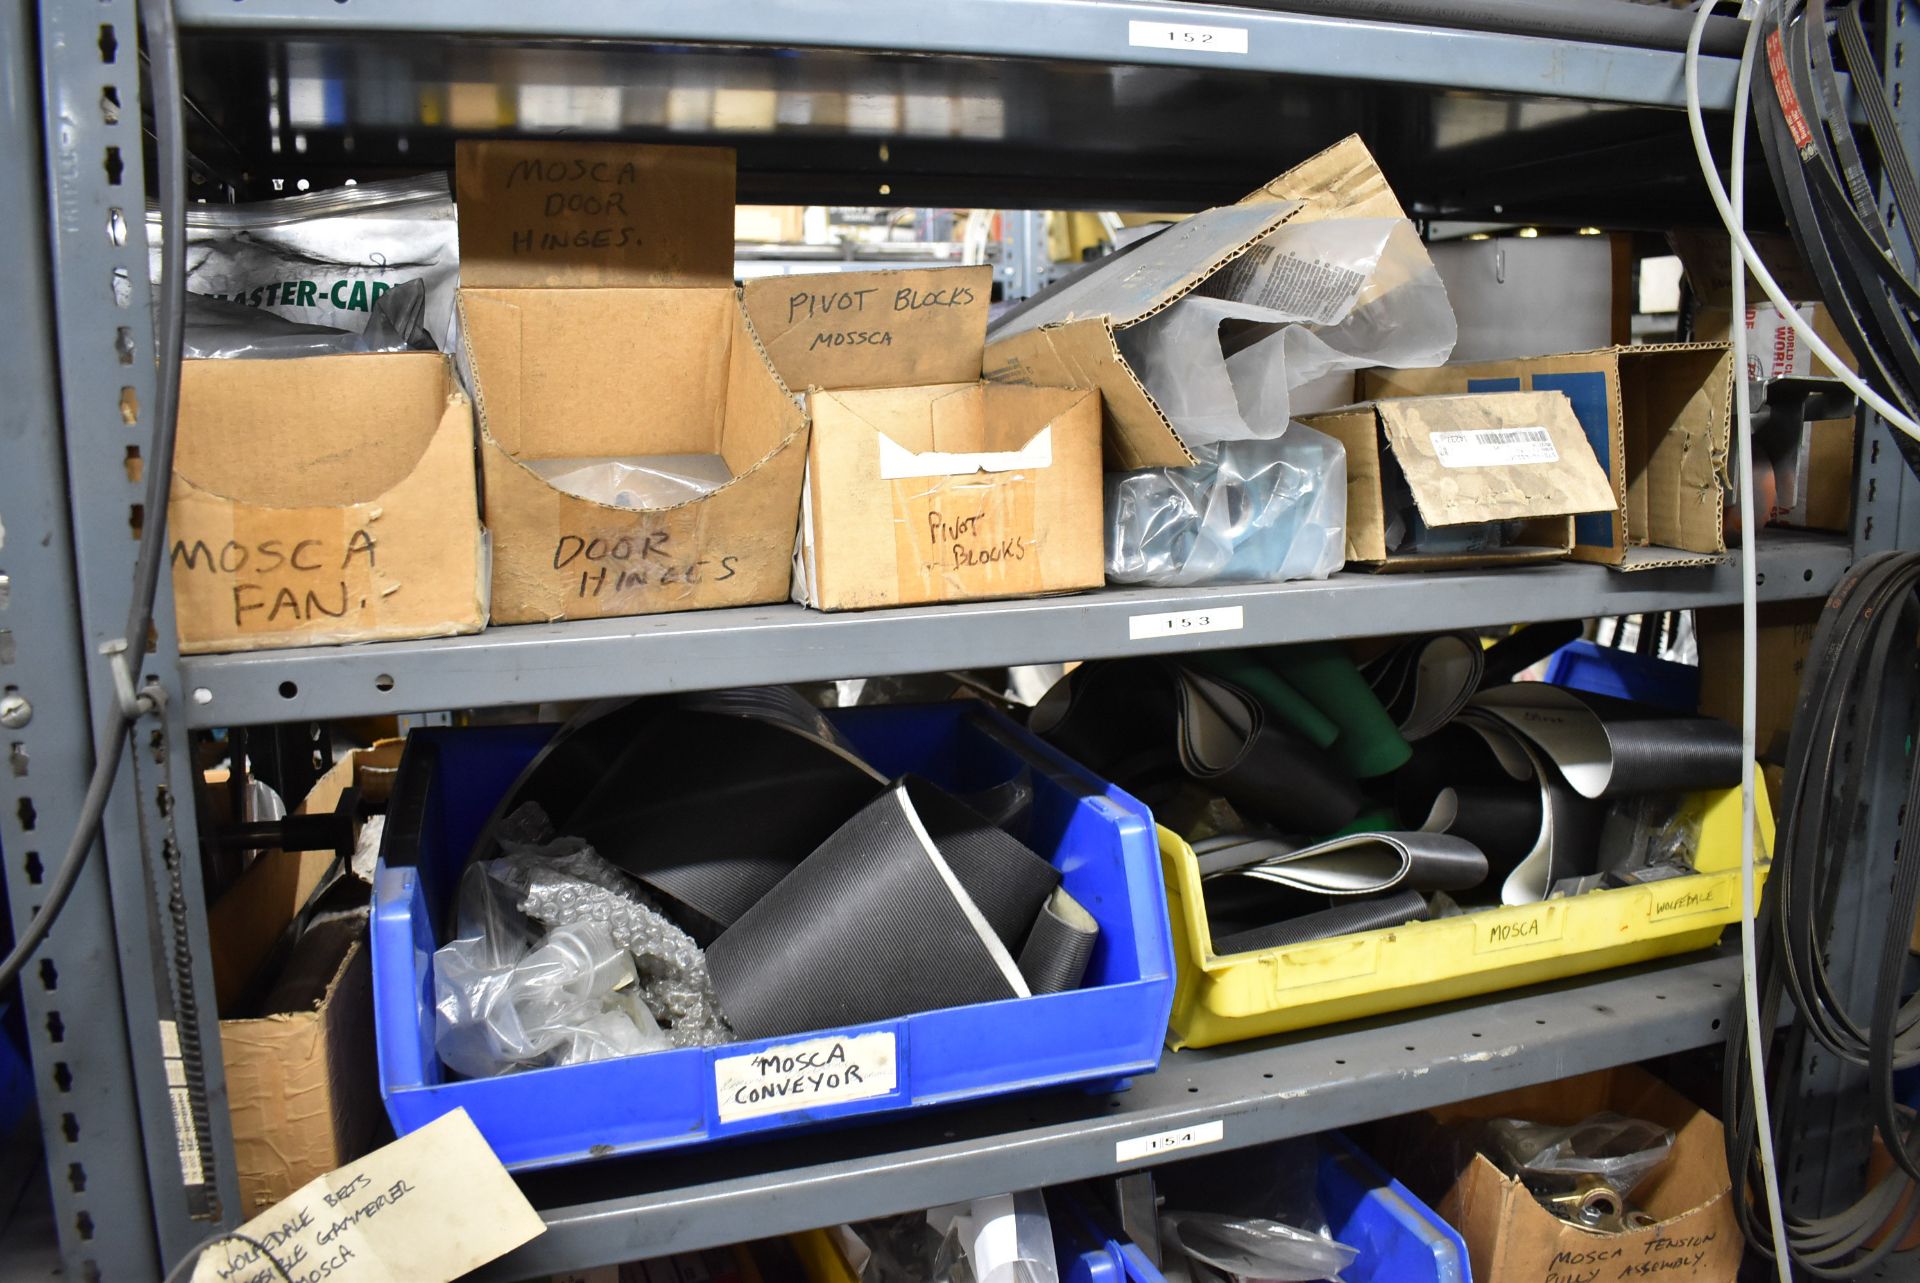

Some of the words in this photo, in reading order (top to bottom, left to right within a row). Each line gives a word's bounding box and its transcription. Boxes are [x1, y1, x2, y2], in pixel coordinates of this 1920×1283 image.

[1168, 31, 1213, 43] 152
[506, 158, 636, 188] MOSCA
[543, 192, 628, 217] DOOR
[788, 287, 879, 323] PIVOT
[893, 287, 974, 312] BLOCKS
[809, 330, 893, 351] MOSSCA
[928, 510, 985, 544] PIVOT
[171, 529, 377, 574] MOSCA
[553, 531, 672, 570] DOOR
[952, 535, 1025, 571] BLOCKS
[1168, 616, 1210, 628] 153
[1656, 891, 1714, 915] WOLFEDALE
[1489, 919, 1539, 944] MOSCA
[757, 1043, 846, 1076] MOSCA
[735, 1065, 864, 1104] CONVEYOR
[1151, 1133, 1191, 1148] 154
[1548, 1247, 1623, 1271] MOSCA
[1644, 1231, 1717, 1255] TENSION
